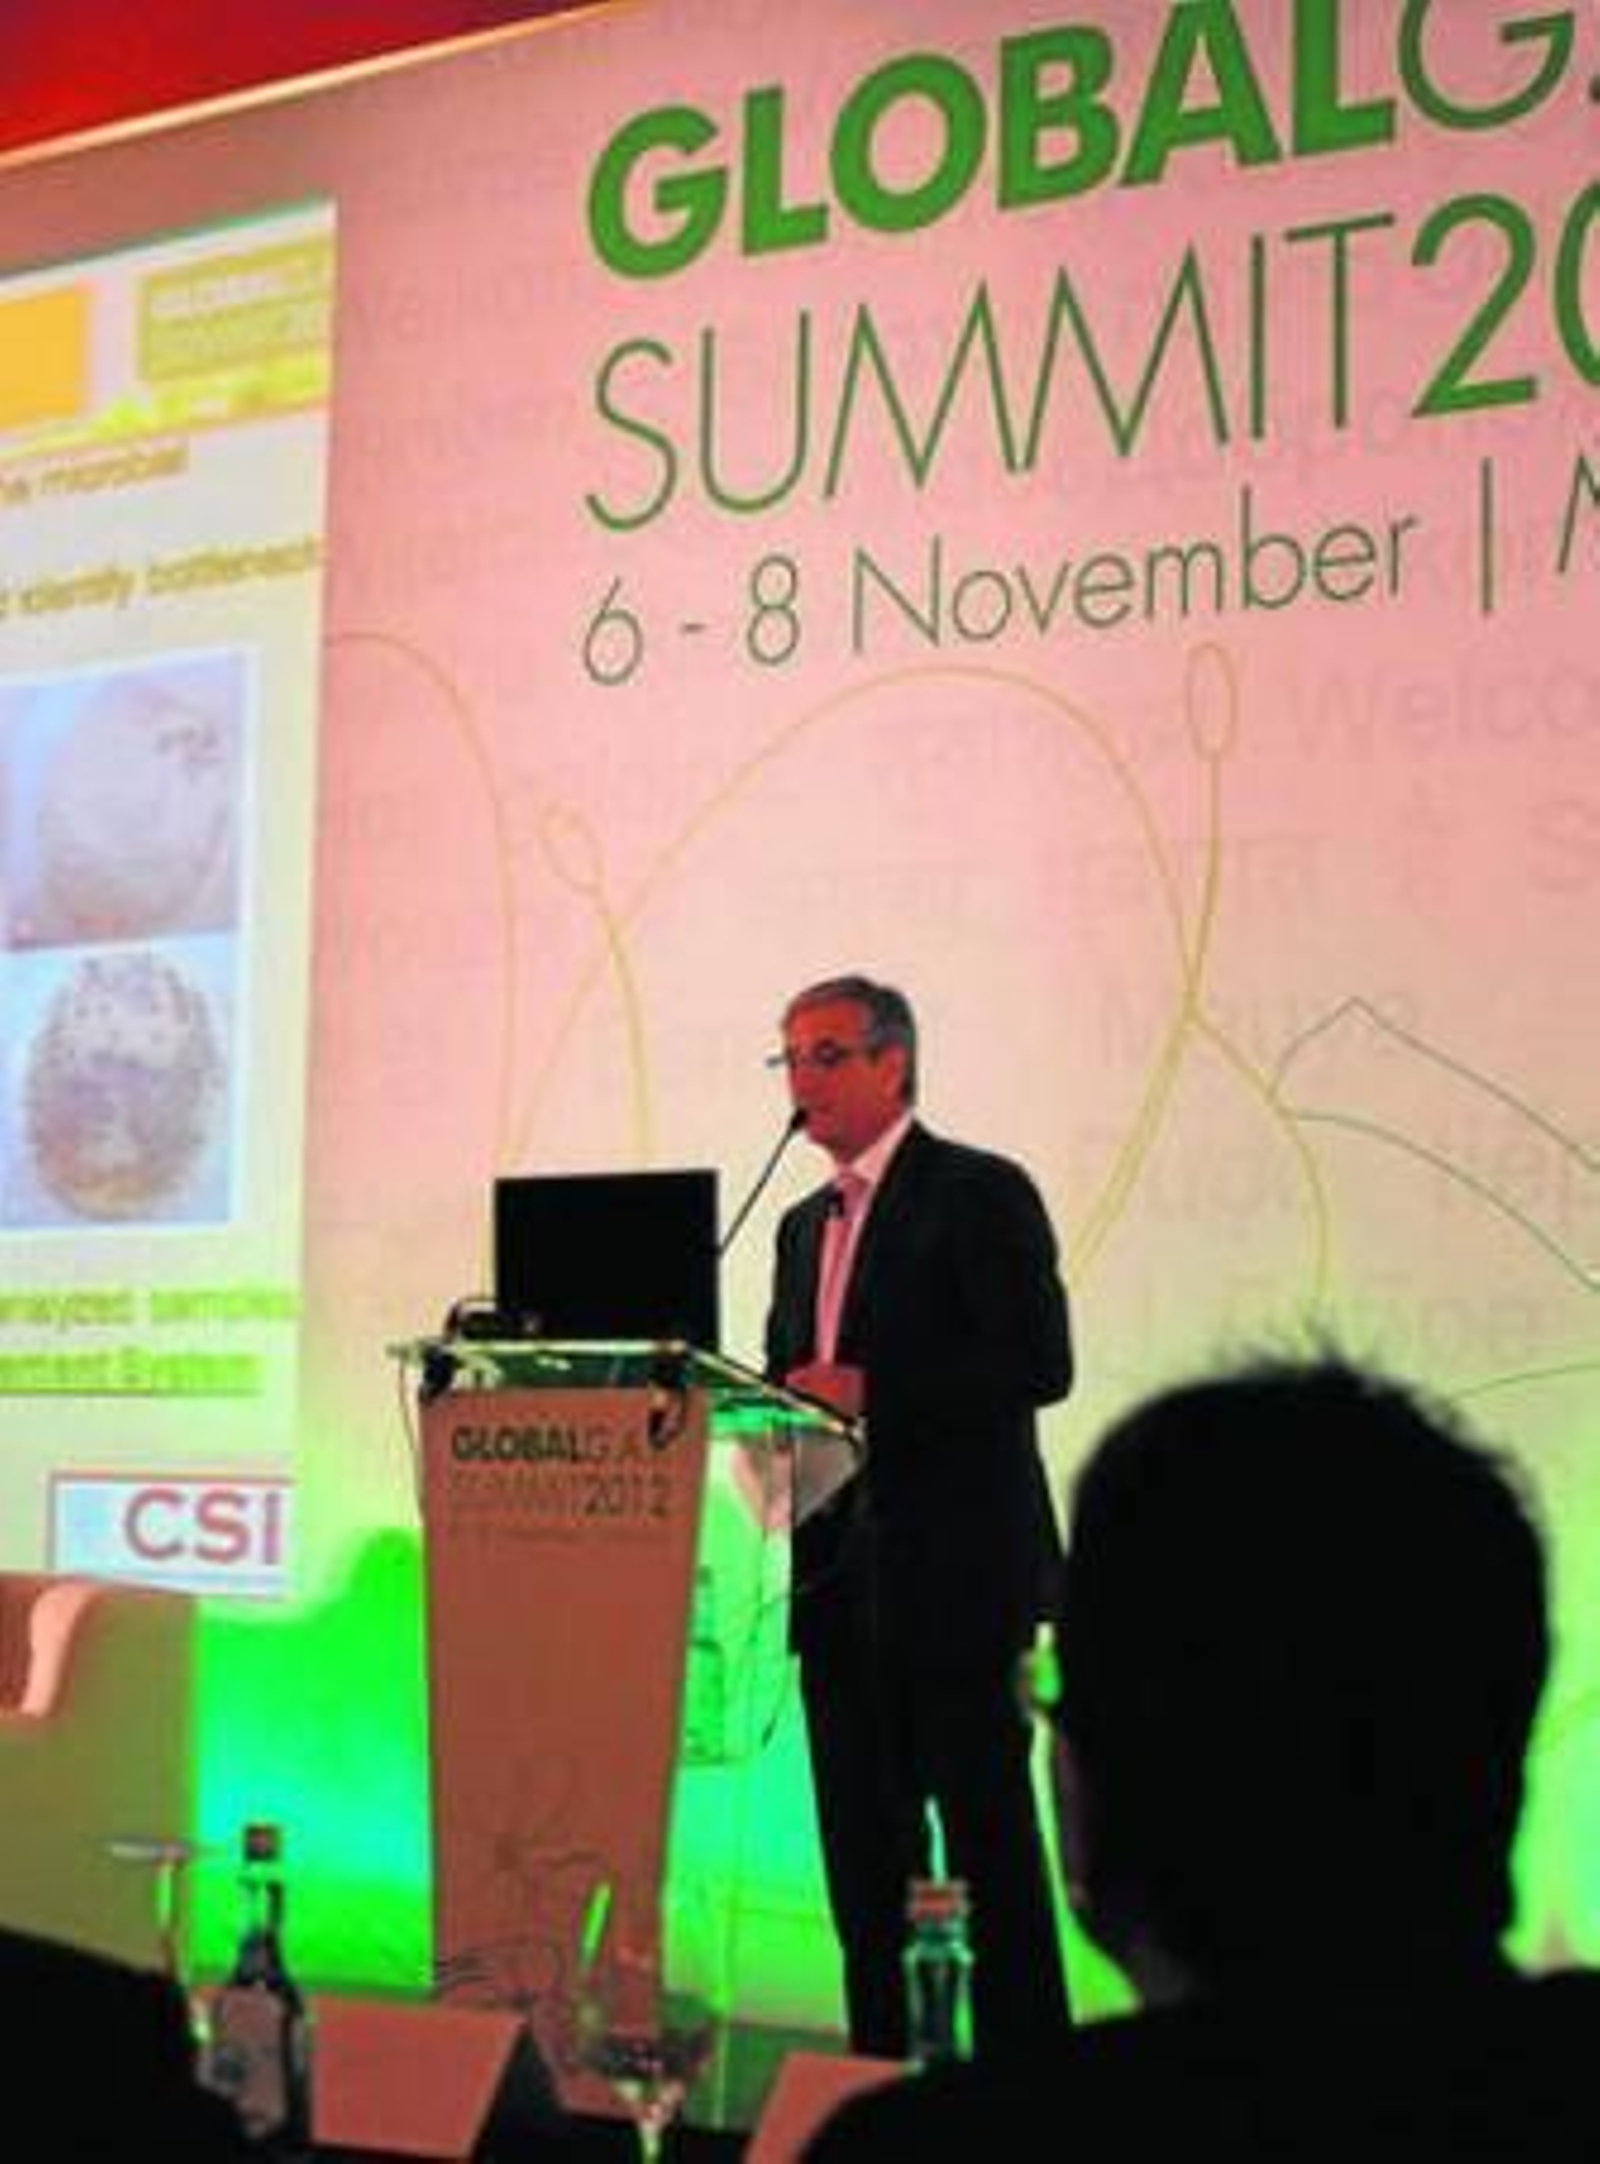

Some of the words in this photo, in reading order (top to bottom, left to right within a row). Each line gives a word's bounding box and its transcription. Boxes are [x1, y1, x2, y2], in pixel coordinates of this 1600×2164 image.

[583, 576, 644, 686] 6
[746, 553, 800, 667] 8
[852, 482, 1419, 656] November
[123, 1487, 282, 1566] CSI
